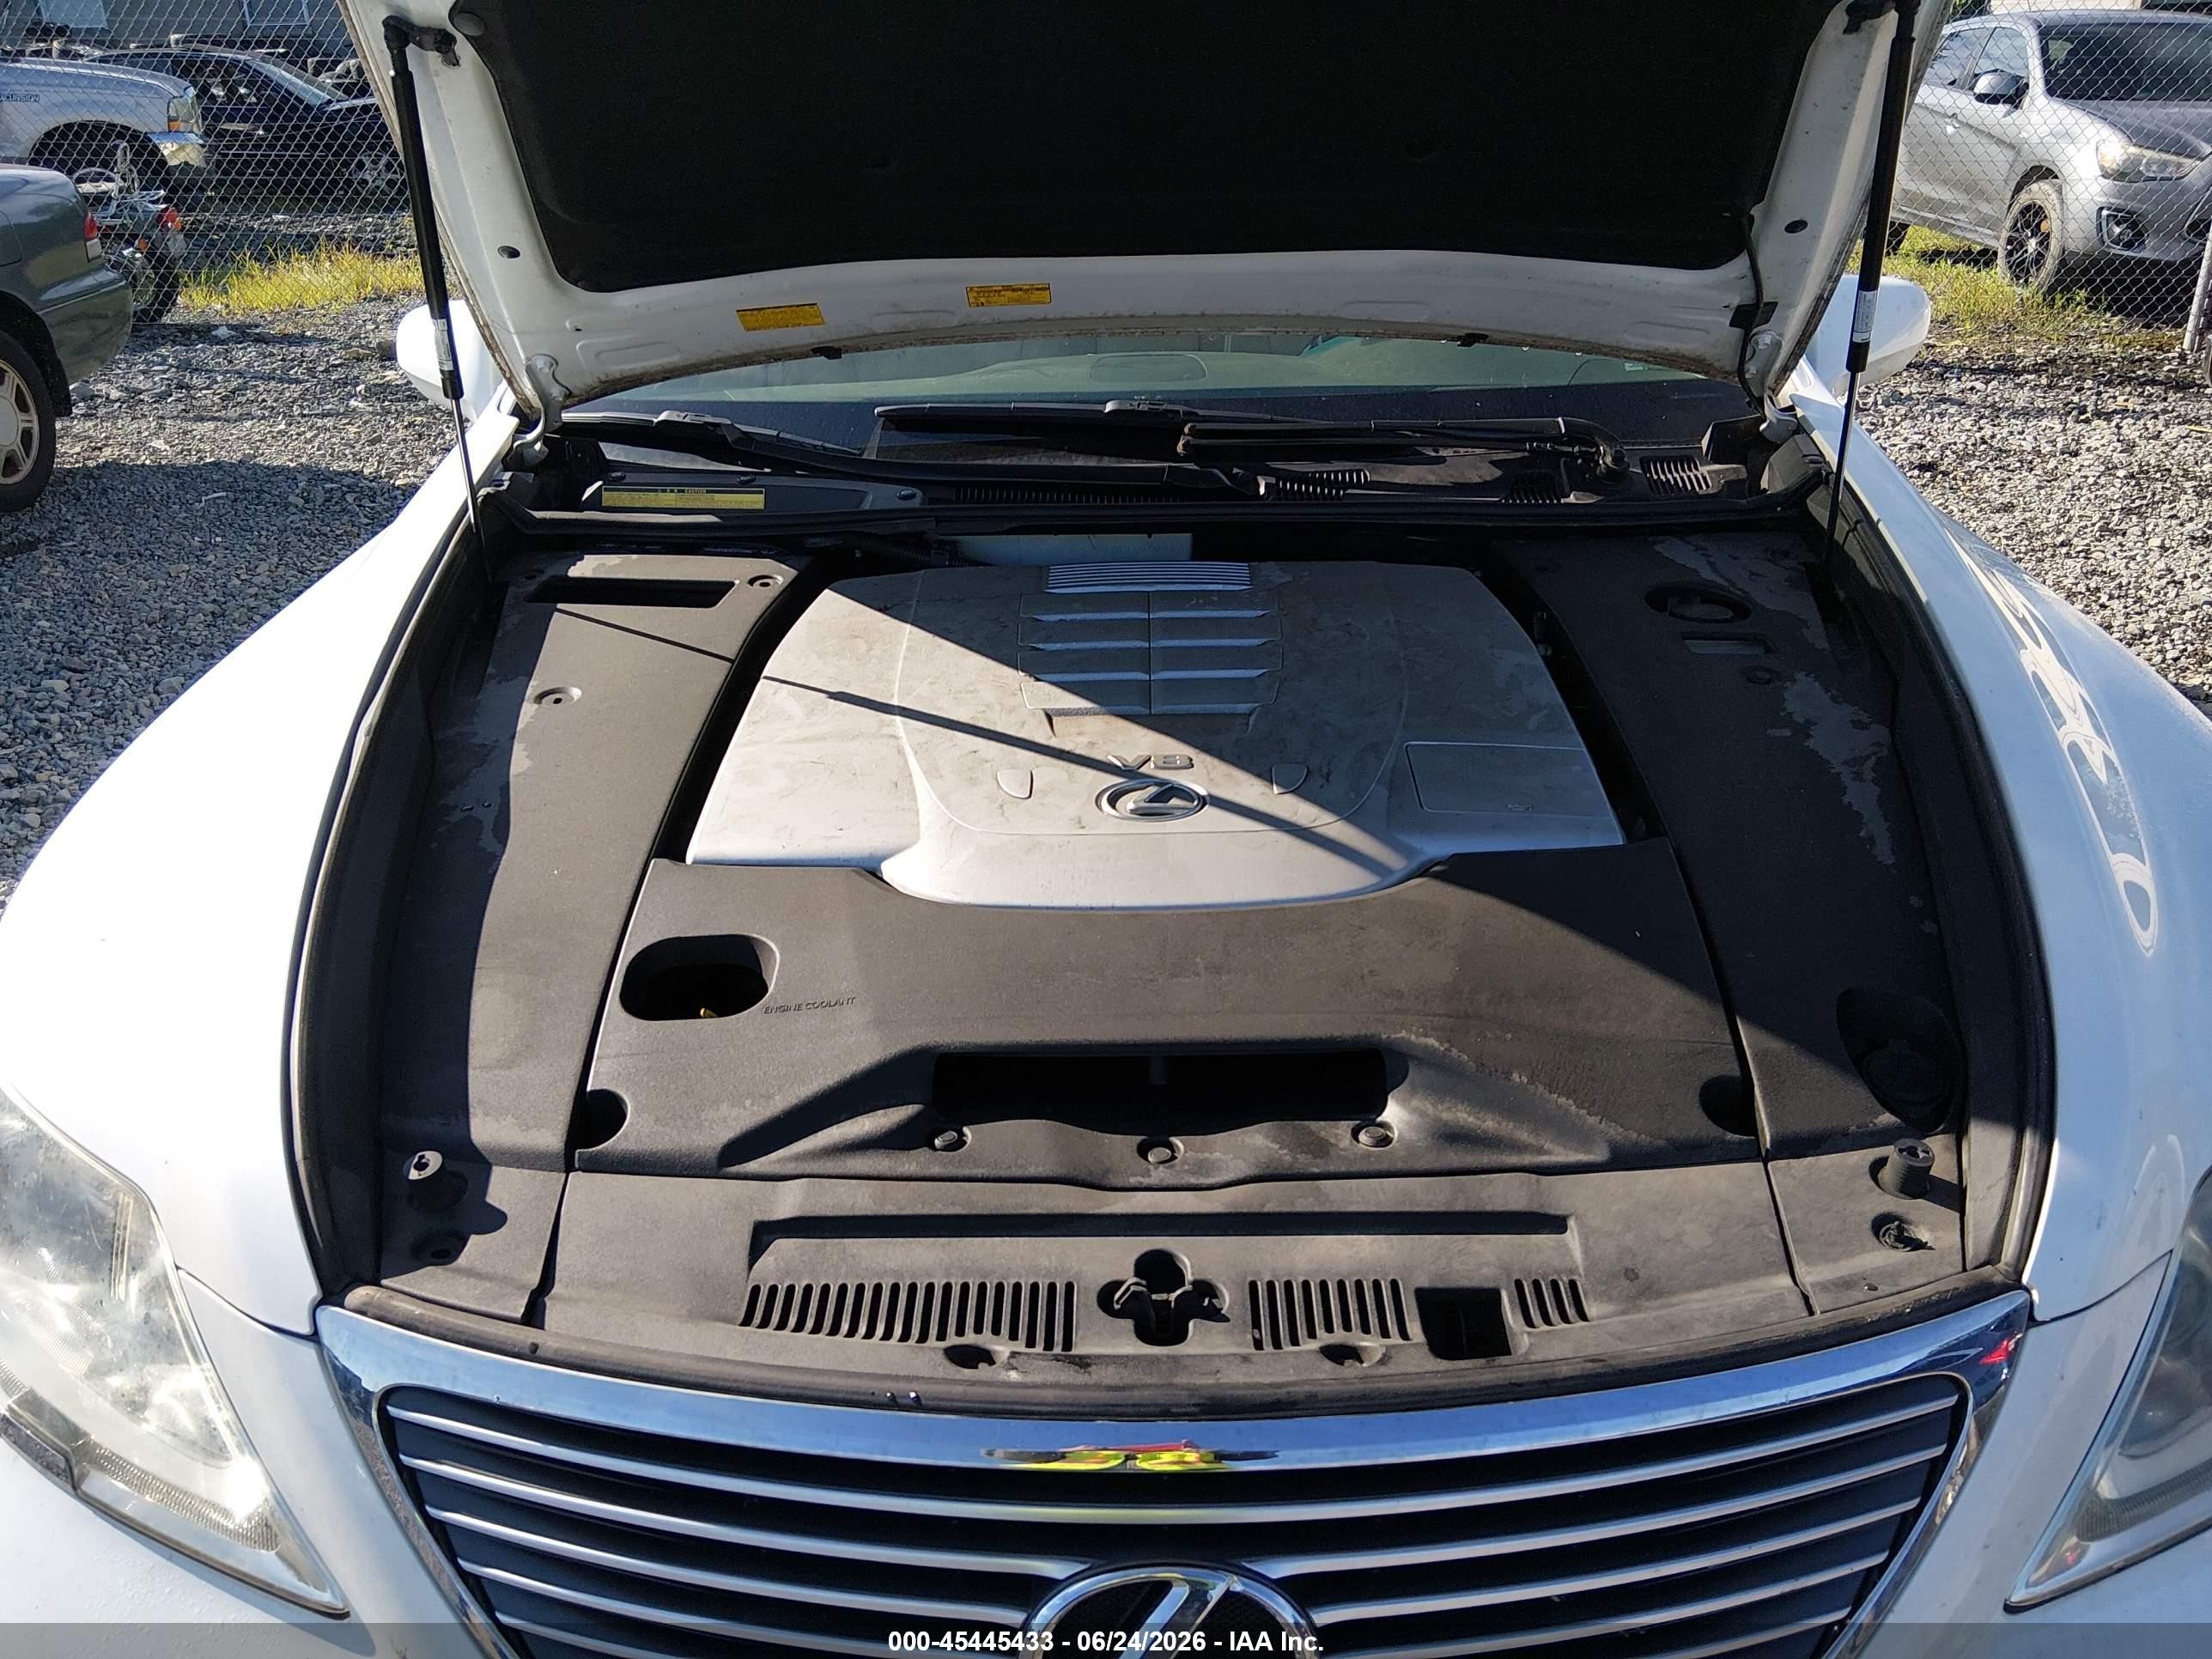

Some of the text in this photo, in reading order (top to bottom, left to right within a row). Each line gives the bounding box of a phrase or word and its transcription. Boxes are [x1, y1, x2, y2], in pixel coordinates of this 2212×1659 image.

[1106, 753, 1195, 771] V8
[763, 997, 856, 1014] ENGINE COOLANT
